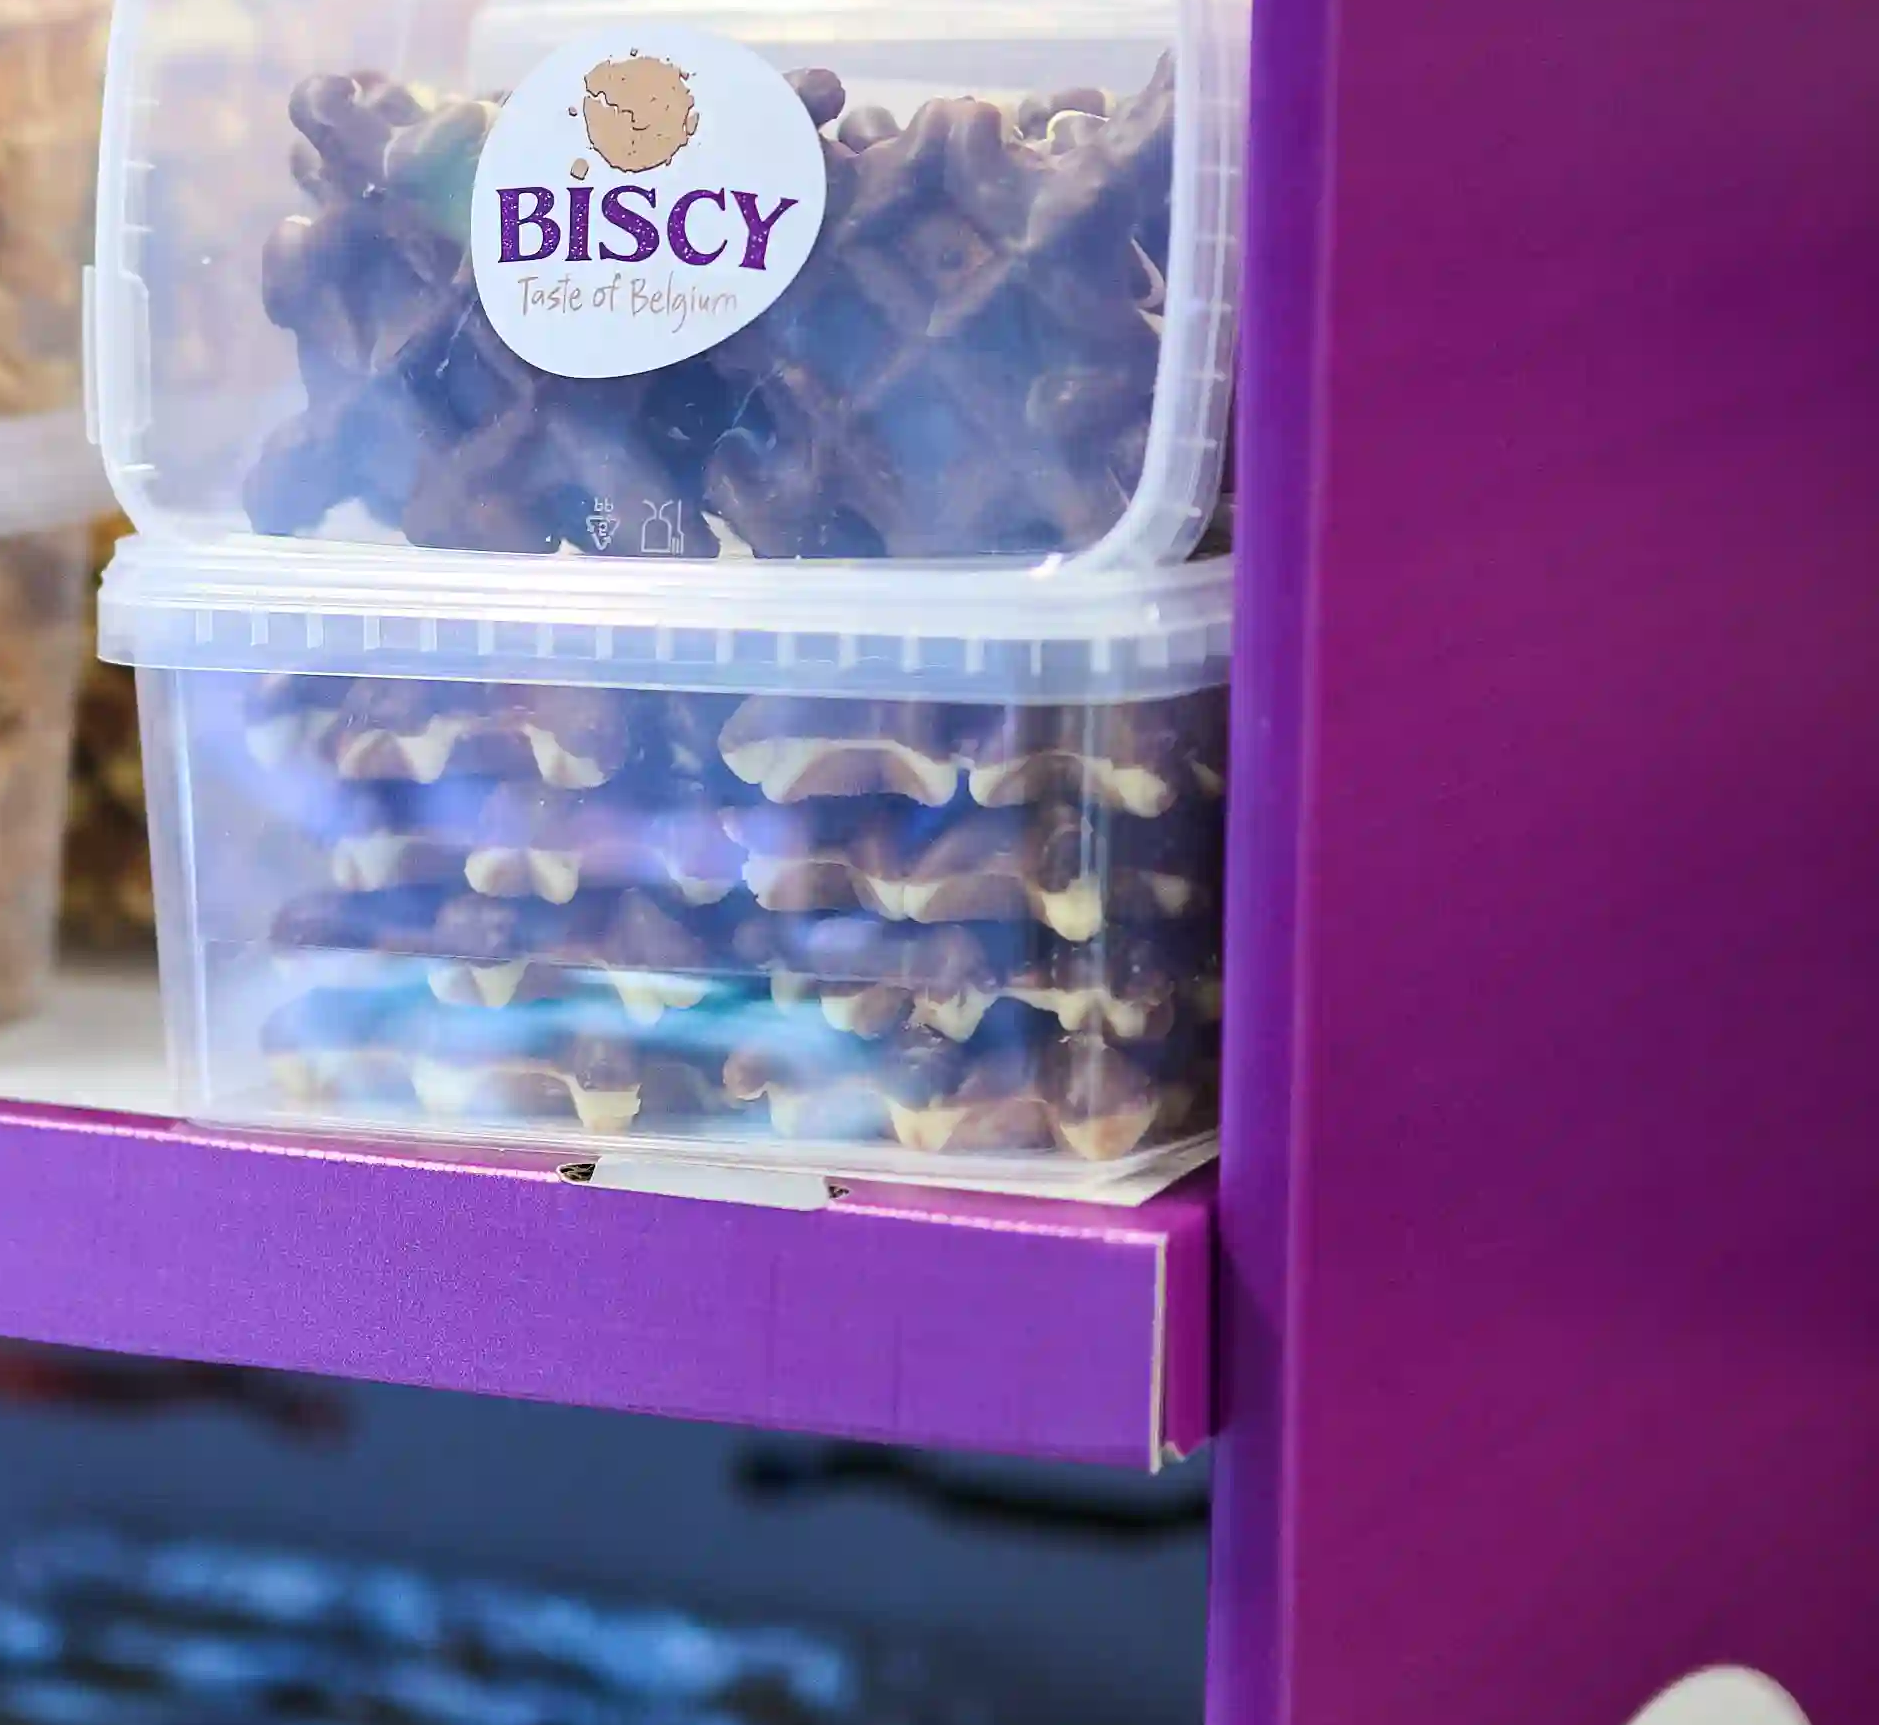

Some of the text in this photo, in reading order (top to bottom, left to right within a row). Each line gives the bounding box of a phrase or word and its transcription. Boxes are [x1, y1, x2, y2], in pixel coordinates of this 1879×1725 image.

[495, 159, 800, 271] BISCY
[517, 270, 738, 333] Taste of Belgium
